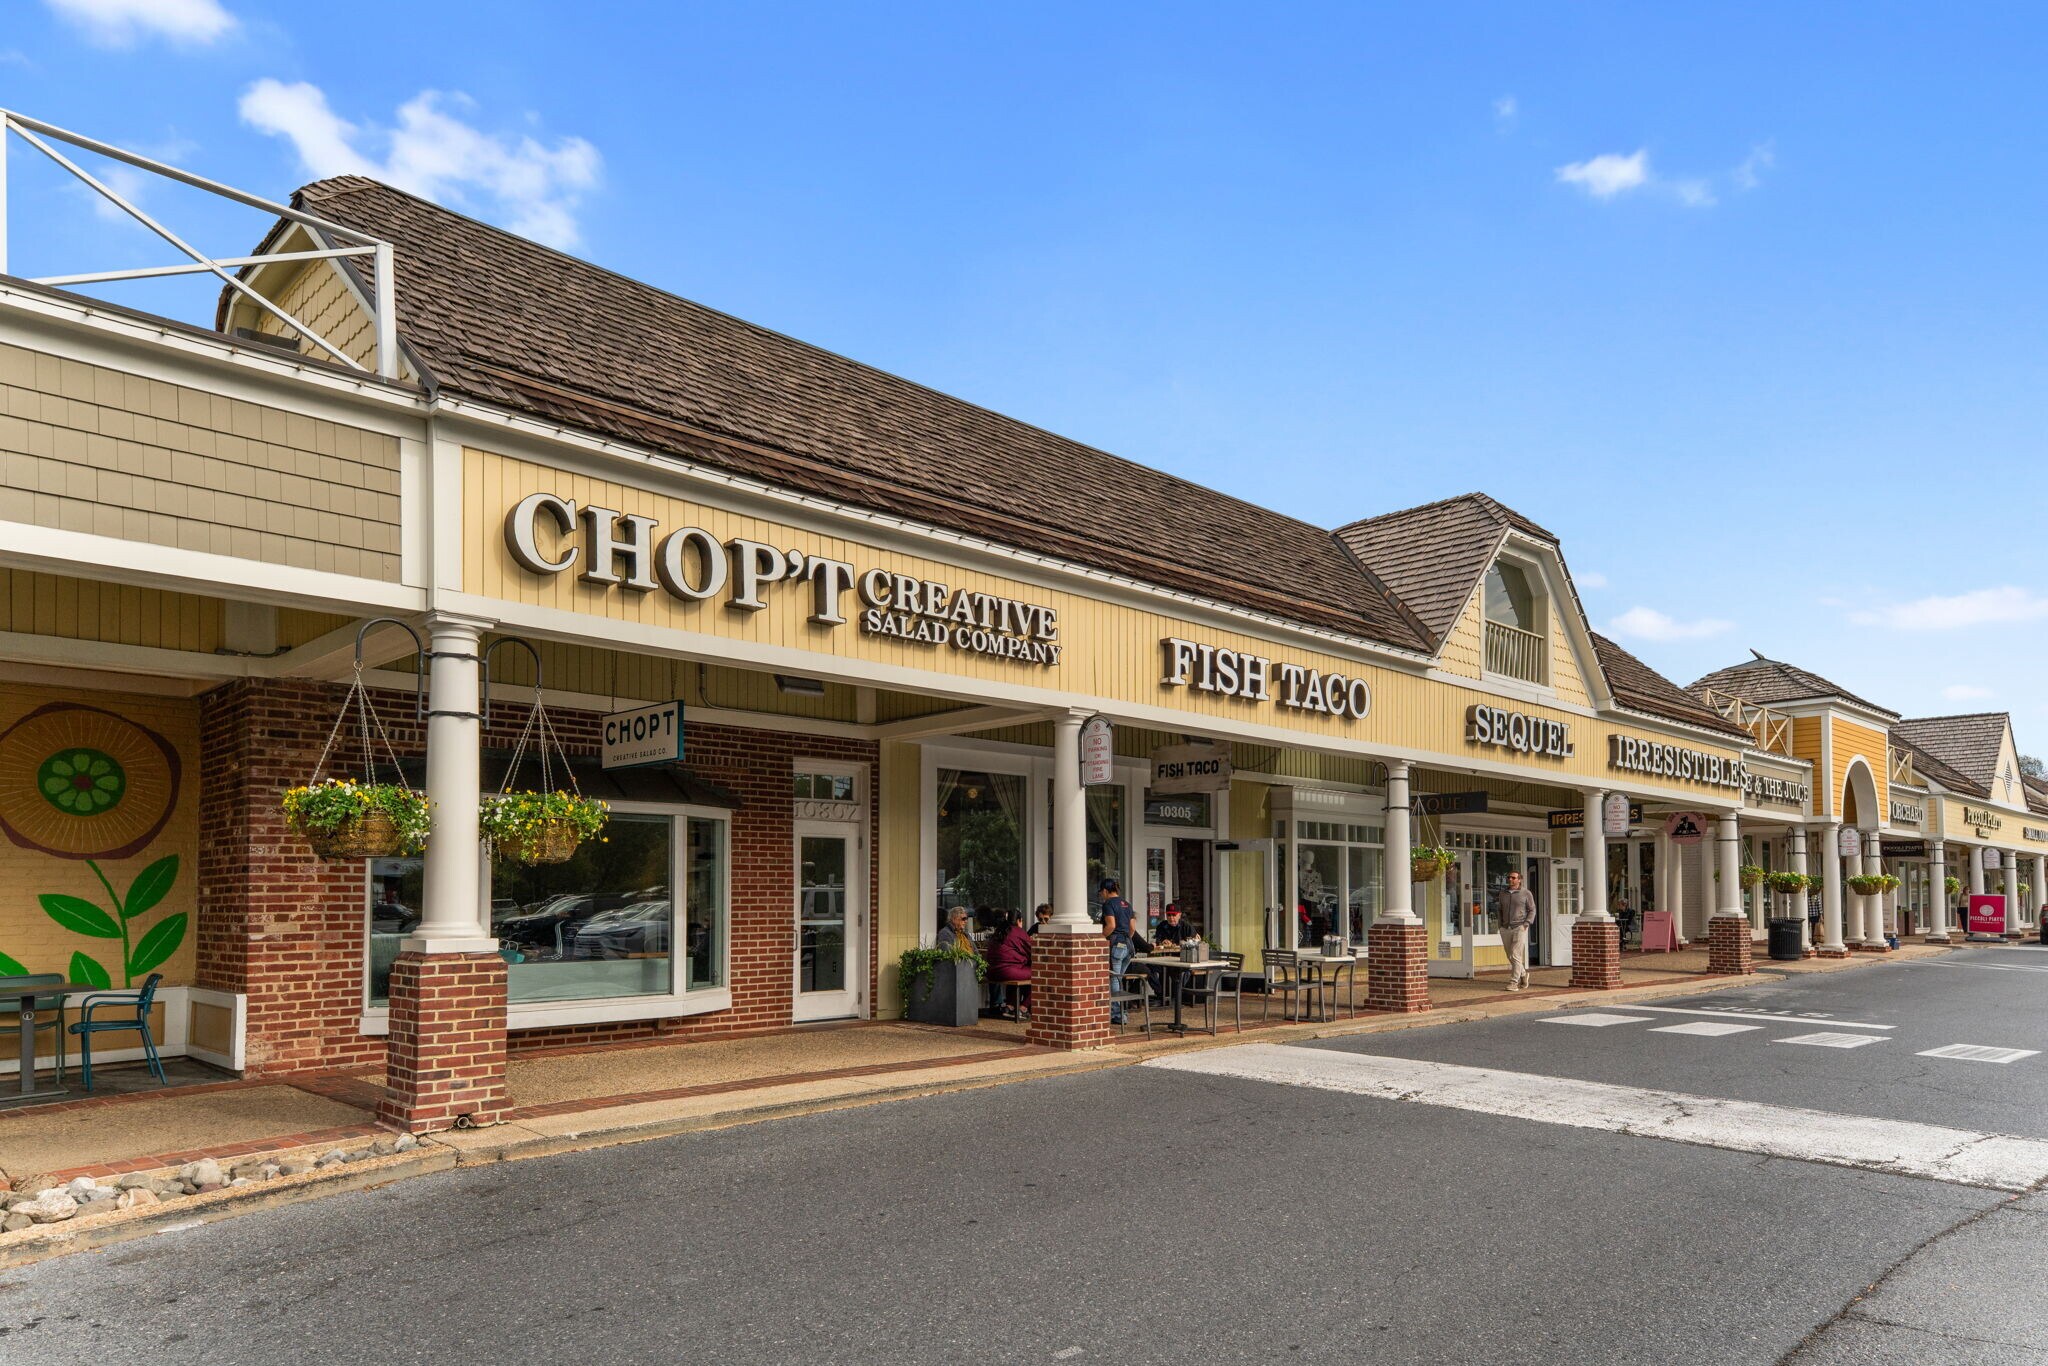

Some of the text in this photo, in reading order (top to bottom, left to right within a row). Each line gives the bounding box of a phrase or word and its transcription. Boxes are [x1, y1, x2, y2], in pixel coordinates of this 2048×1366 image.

[862, 568, 1057, 641] CREATIVE
[863, 609, 1062, 665] SALAD COMPANY
[1166, 637, 1371, 720] FISH TACO
[605, 709, 675, 746] CHOPT
[1093, 737, 1102, 746] NO
[1470, 704, 1575, 758] SEQUEL
[612, 751, 638, 761] CREATIVE
[639, 748, 657, 759] SALAD
[1158, 759, 1219, 779] FISH TACO
[1612, 735, 1747, 788] IRRESISTIBLES
[1754, 775, 1762, 794] &
[1763, 776, 1783, 798] THE
[1784, 781, 1809, 802] JUICE
[1159, 805, 1192, 819] 10305
[1893, 801, 1924, 822] ORCHARD
